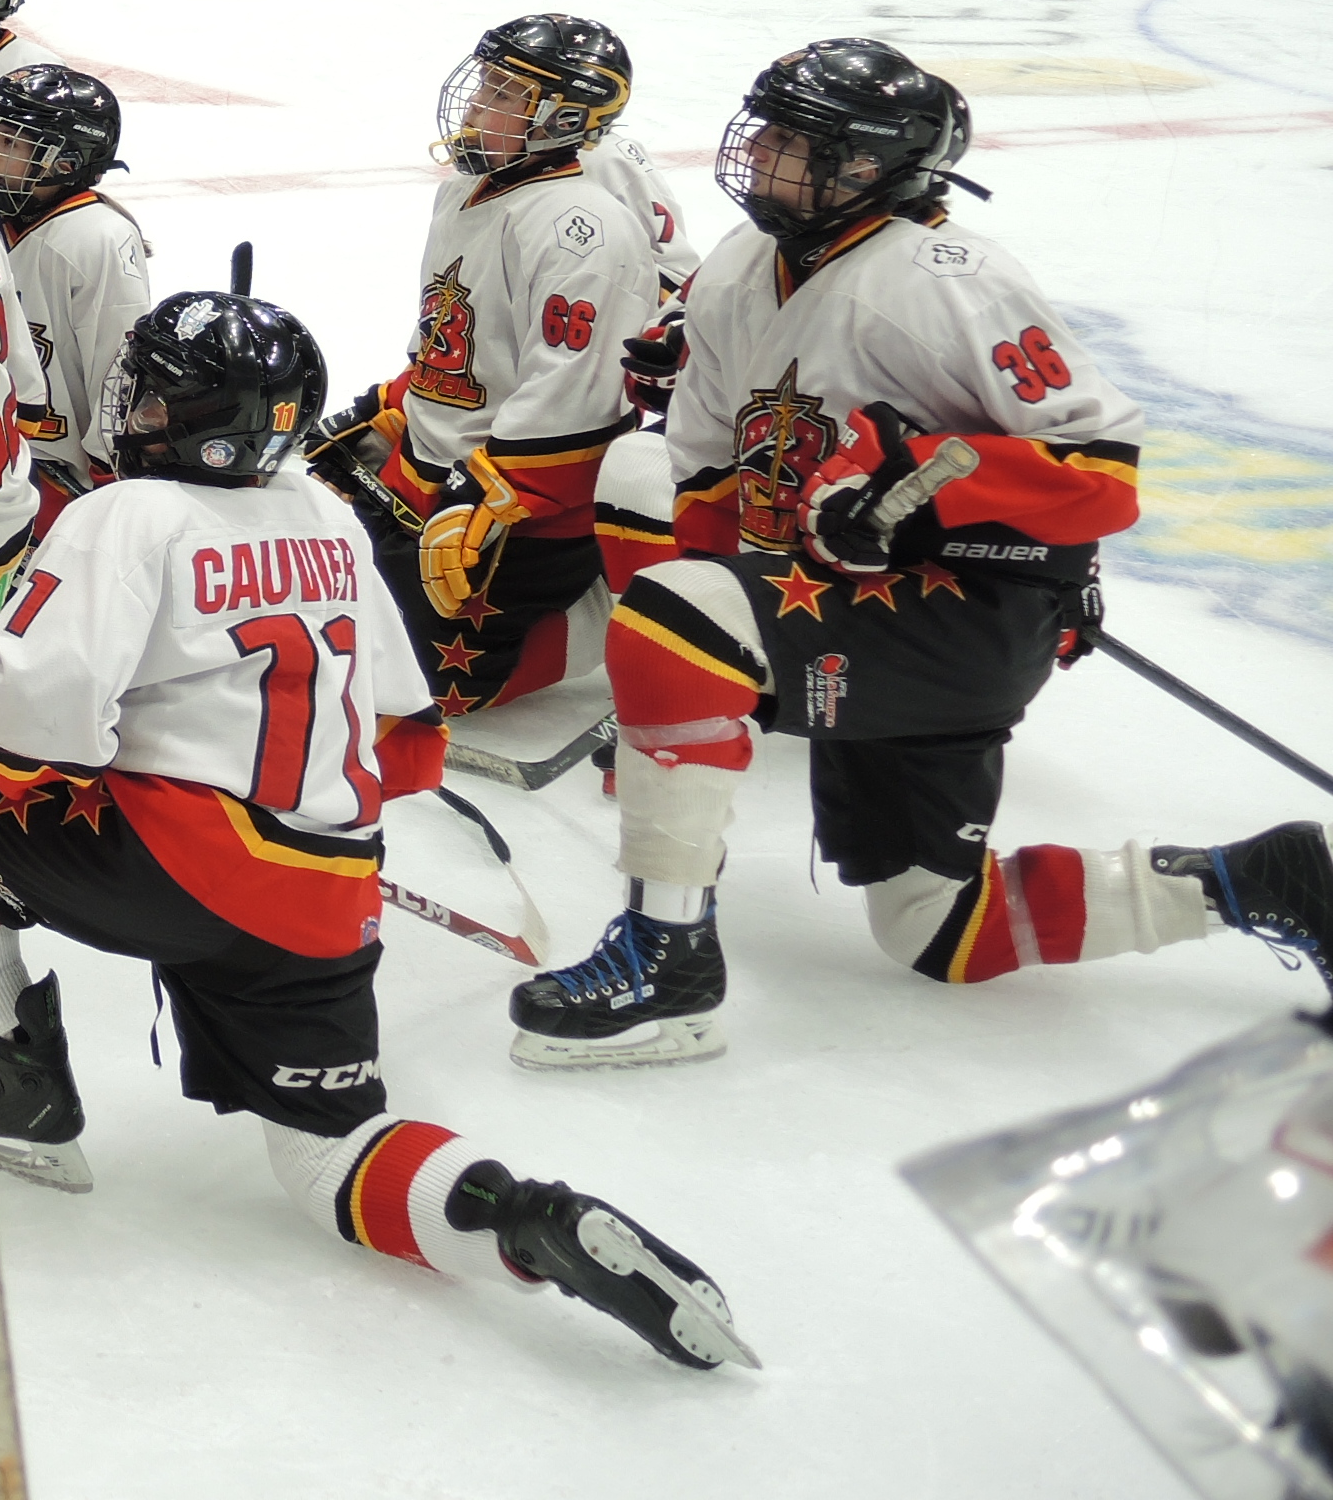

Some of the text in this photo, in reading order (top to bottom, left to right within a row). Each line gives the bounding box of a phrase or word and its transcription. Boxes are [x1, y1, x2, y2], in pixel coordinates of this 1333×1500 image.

[541, 293, 596, 351] 66
[993, 325, 1072, 405] 36
[272, 401, 298, 432] 11
[940, 542, 1049, 562] BAUER
[271, 1060, 381, 1091] CCM
